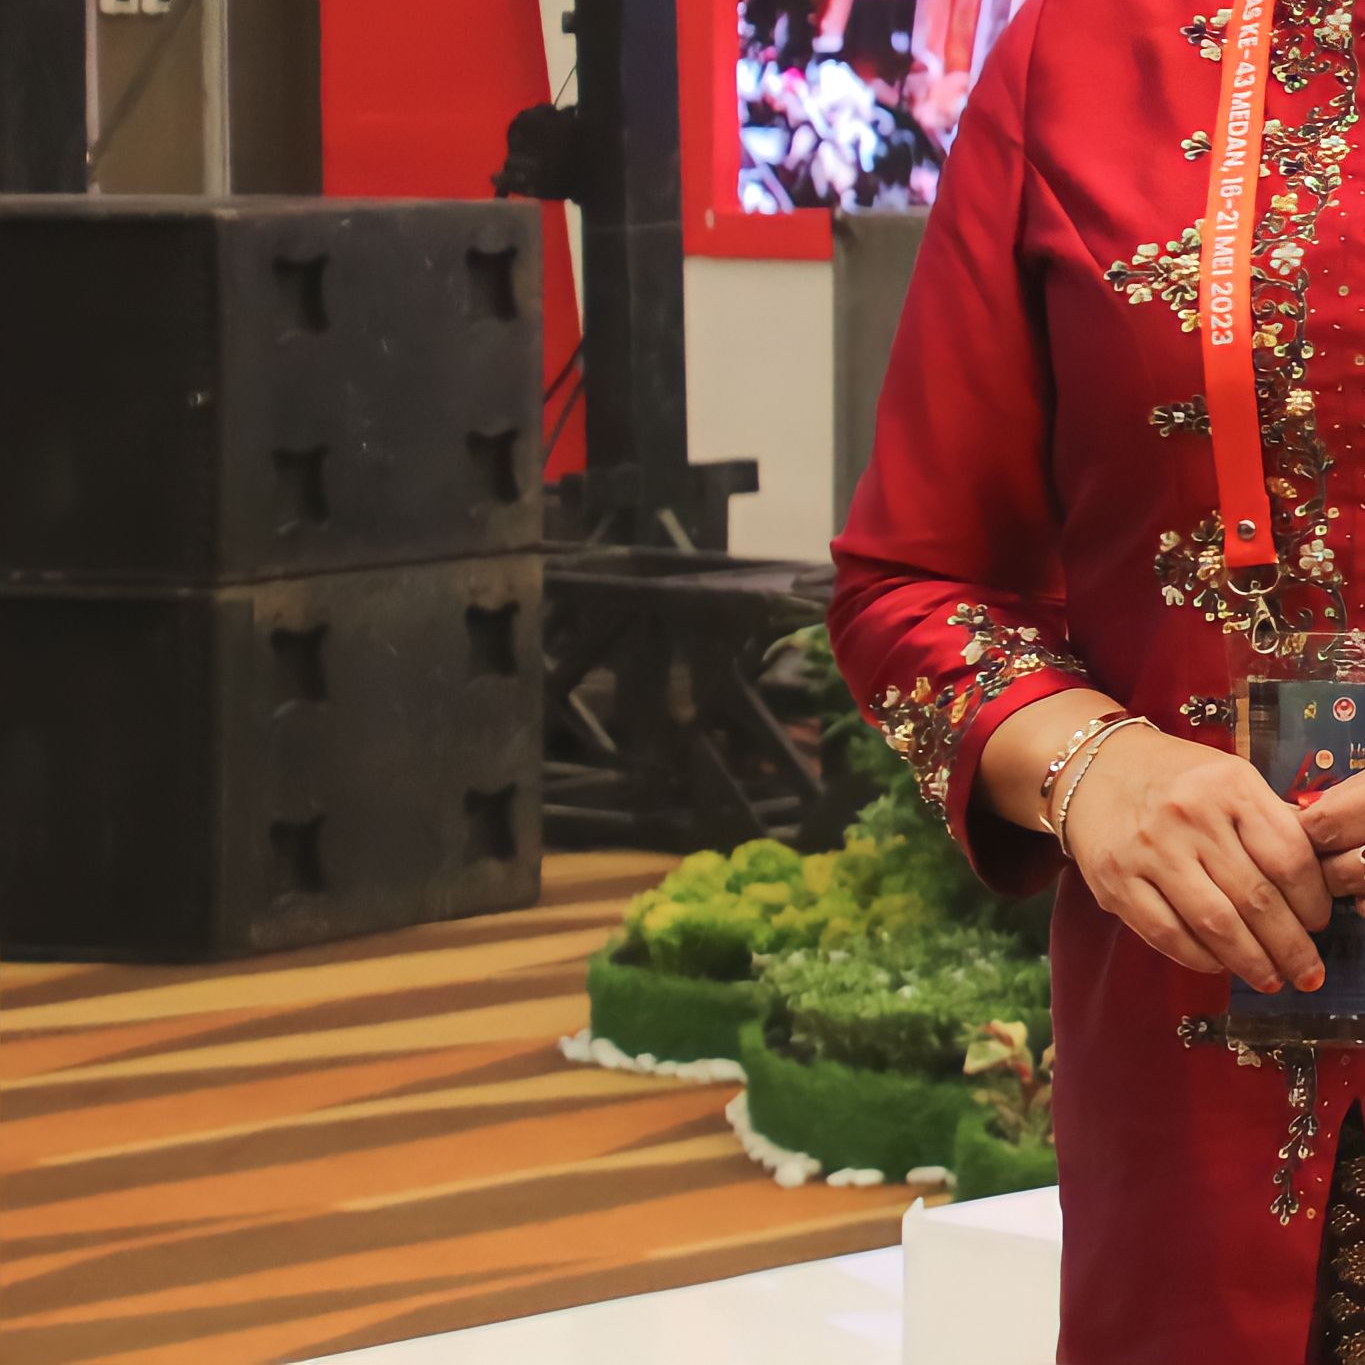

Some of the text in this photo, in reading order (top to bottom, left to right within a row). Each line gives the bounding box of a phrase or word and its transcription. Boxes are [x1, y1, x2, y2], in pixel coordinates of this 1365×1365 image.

[1220, 91, 1253, 172] MEDAN,
[1211, 236, 1235, 276] MEI
[1210, 283, 1234, 346] 2023
